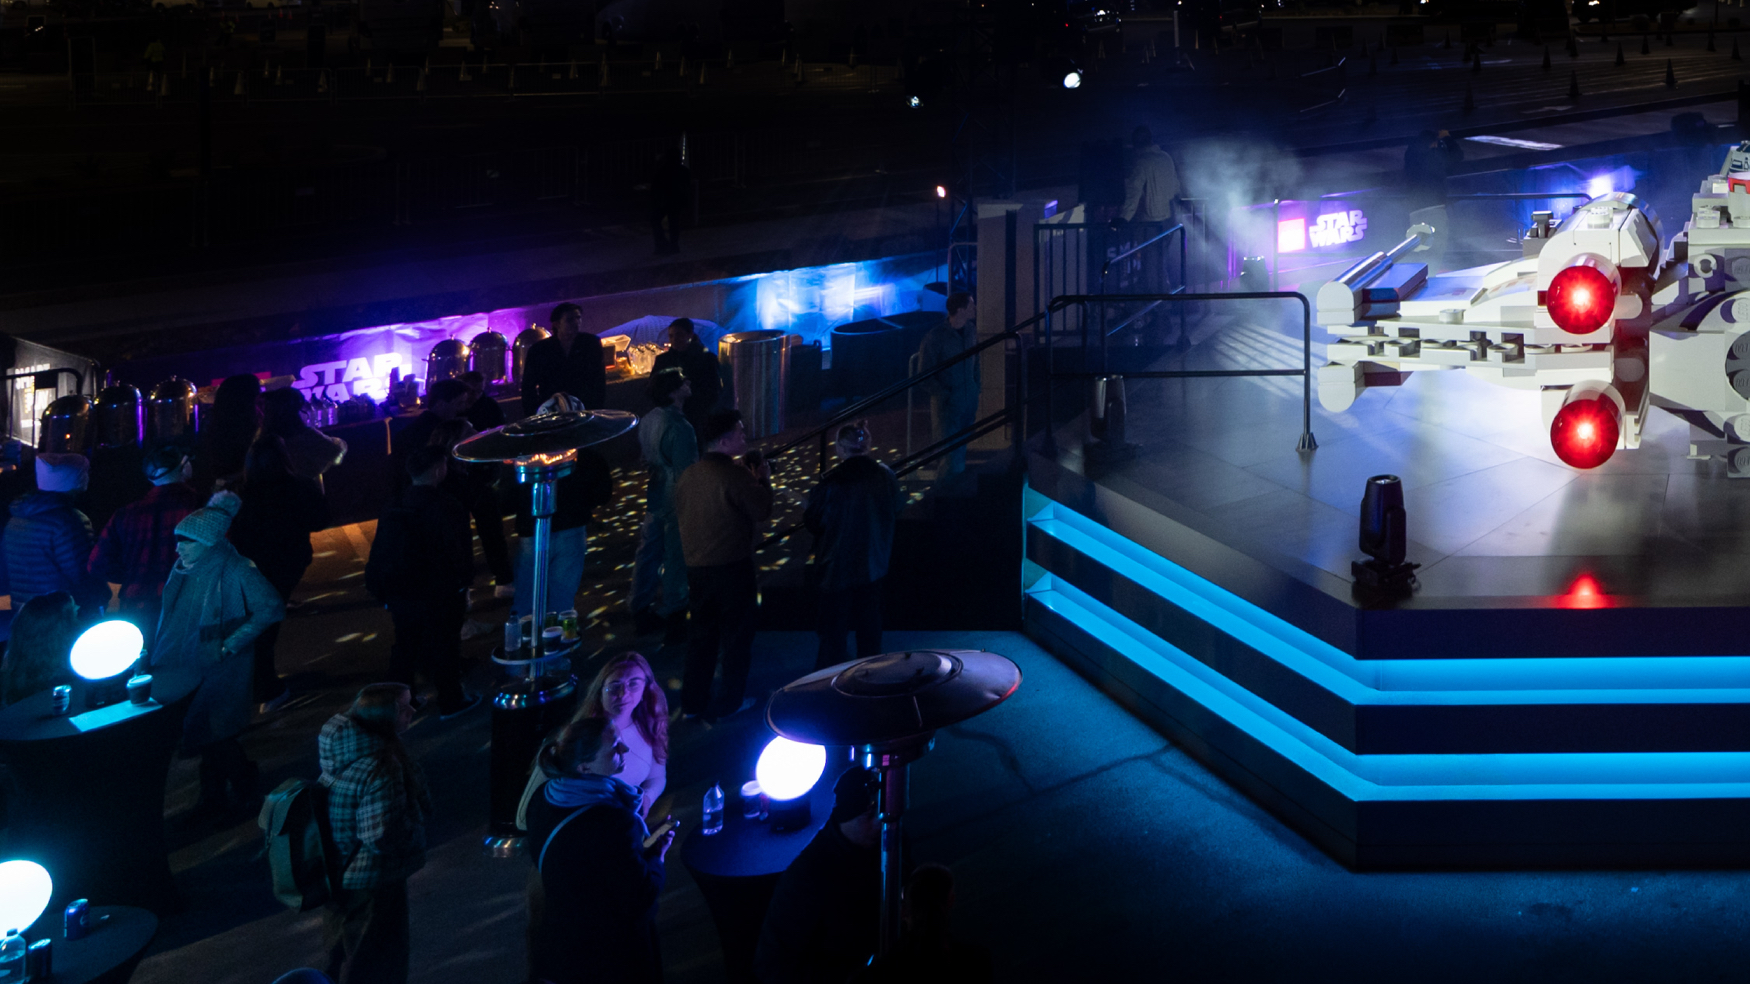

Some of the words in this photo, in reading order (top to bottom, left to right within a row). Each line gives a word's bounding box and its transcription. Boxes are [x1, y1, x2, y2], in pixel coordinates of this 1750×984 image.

[1308, 209, 1368, 232] STAR
[1308, 223, 1368, 248] WARS
[291, 352, 412, 390] STAR
